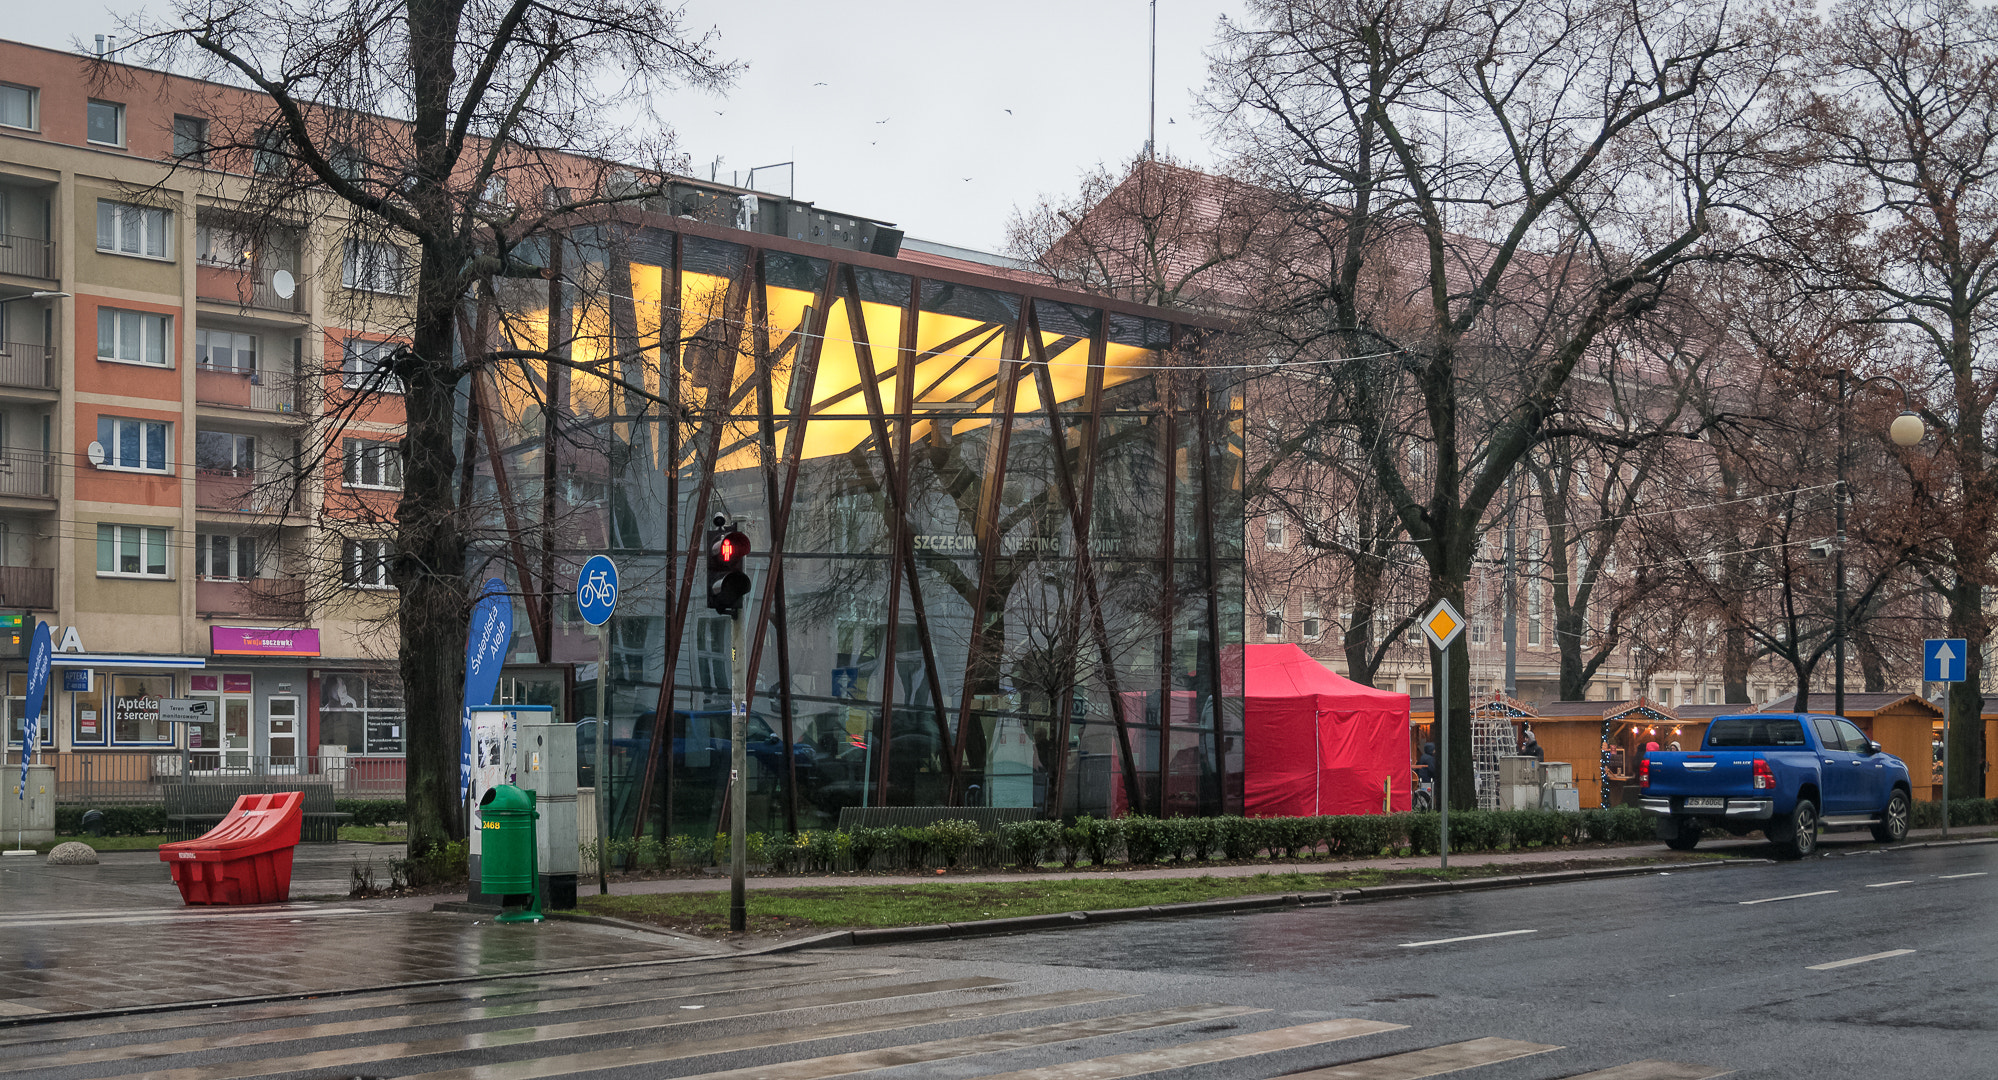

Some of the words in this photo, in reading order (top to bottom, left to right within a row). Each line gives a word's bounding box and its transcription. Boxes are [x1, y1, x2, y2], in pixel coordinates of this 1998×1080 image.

[913, 535, 977, 550] SZCZECIN
[1003, 536, 1060, 551] MEETING
[471, 605, 498, 675] Świetlista
[490, 620, 506, 661] Aleja
[66, 671, 87, 681] APTEKA
[117, 697, 158, 712] Apteka
[116, 711, 122, 720] z
[124, 711, 159, 720] sercem
[482, 820, 501, 830] 2468
